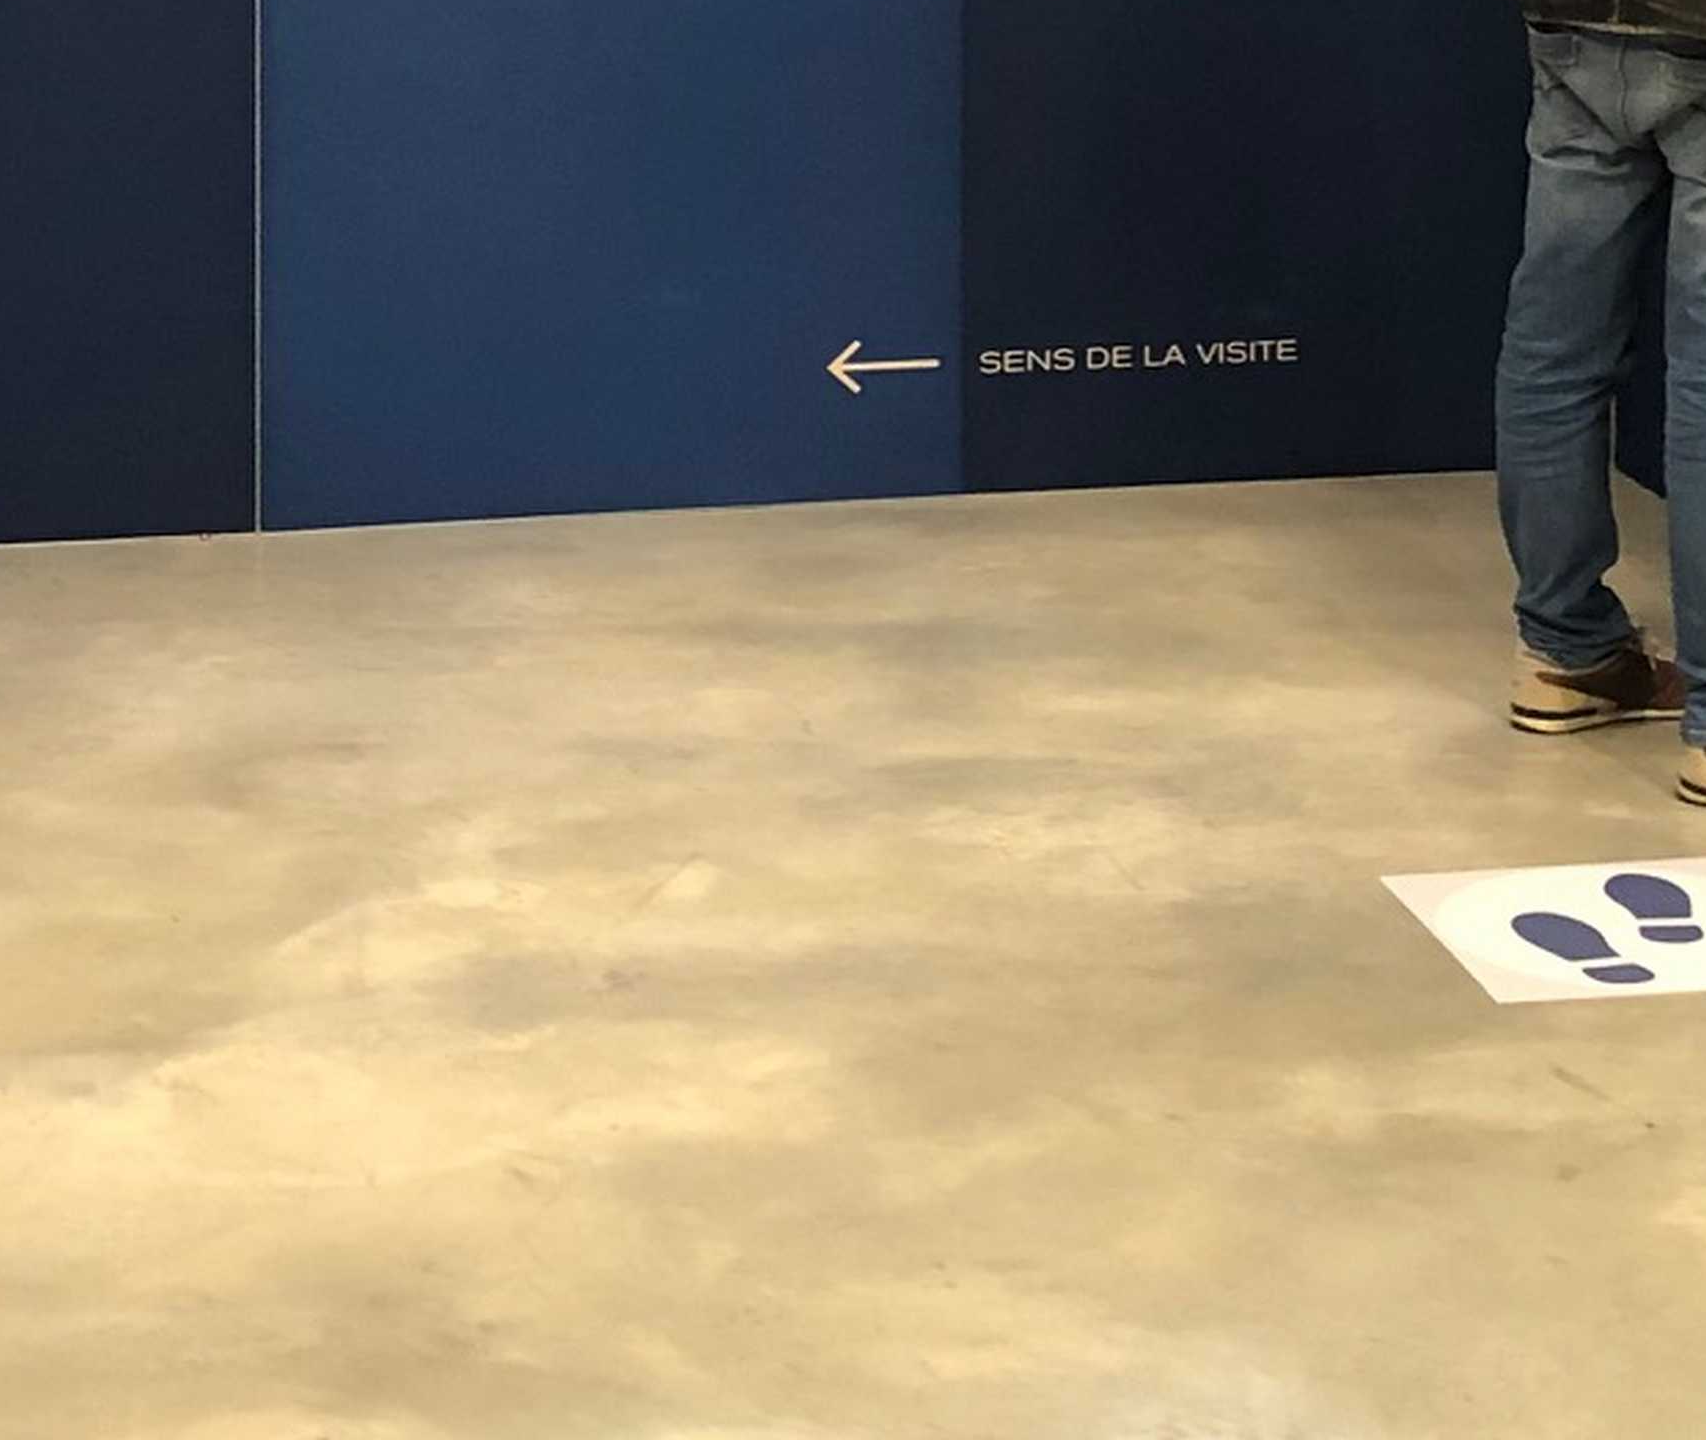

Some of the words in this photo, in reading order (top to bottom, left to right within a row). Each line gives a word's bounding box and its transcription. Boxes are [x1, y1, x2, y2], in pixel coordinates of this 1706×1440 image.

[979, 348, 1076, 375] SENS
[1086, 345, 1133, 369] DE
[1144, 343, 1186, 367] LA
[1197, 338, 1298, 365] VISITE
